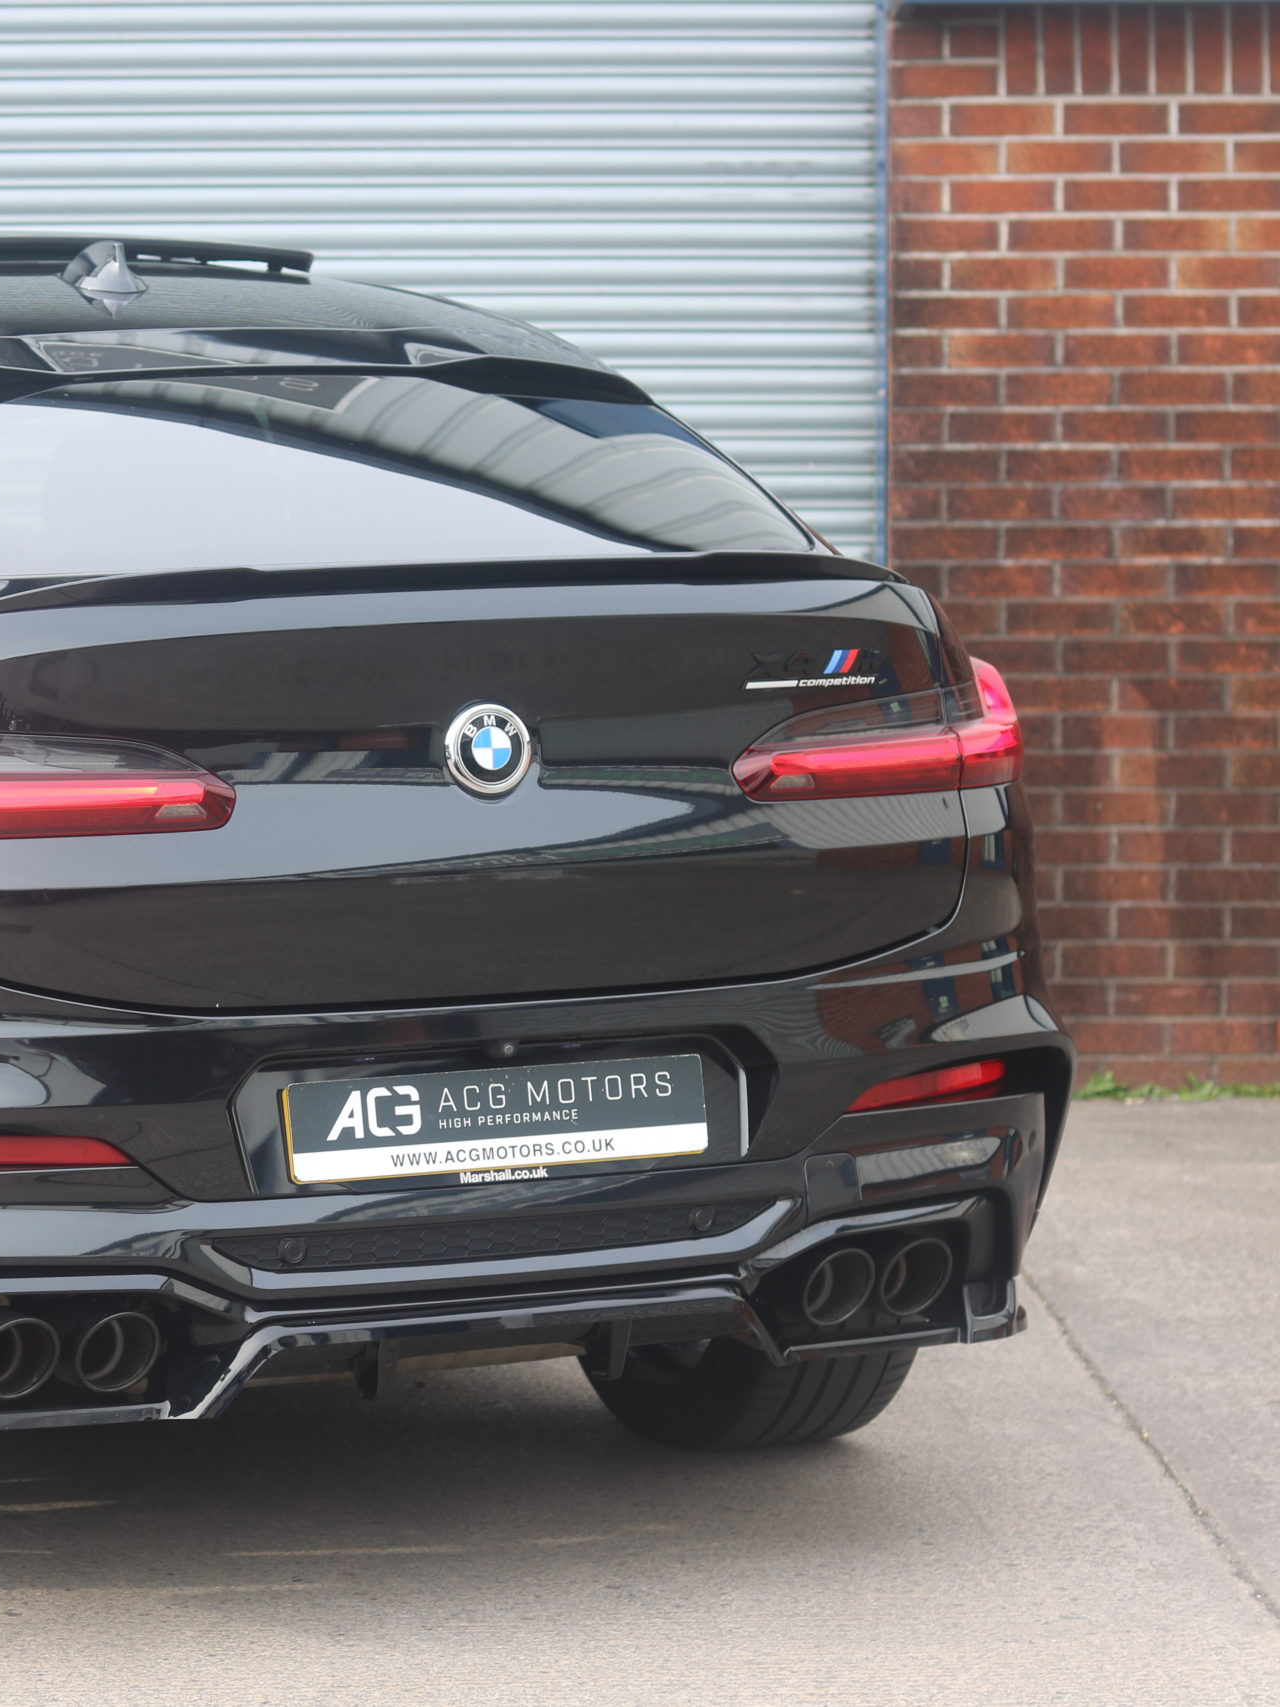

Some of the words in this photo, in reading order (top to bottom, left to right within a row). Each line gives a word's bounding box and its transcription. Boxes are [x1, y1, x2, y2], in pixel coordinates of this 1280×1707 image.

[798, 675, 875, 687] competition
[463, 715, 517, 738] BMW
[438, 1083, 507, 1113] ACG
[527, 1071, 672, 1106] MOTORS
[326, 1085, 422, 1142] ACG
[439, 1115, 472, 1129] HIGH
[477, 1109, 579, 1126] PERFORMANCE
[391, 1137, 615, 1168] WWW.ACGMOTORS.CO.UK
[459, 1166, 549, 1184] Marshall.co.uk
